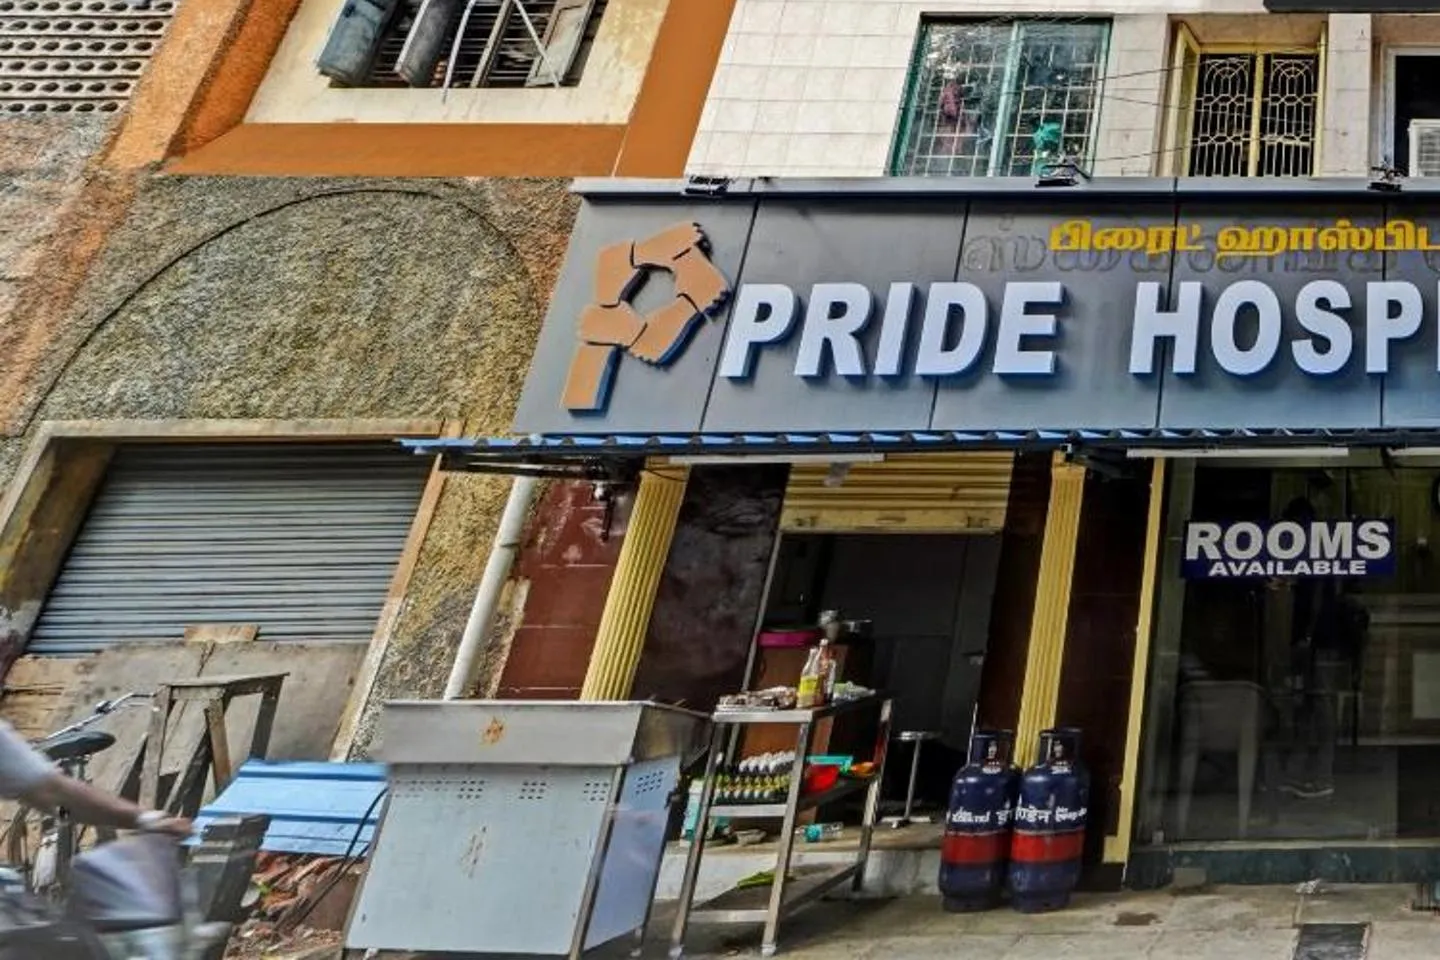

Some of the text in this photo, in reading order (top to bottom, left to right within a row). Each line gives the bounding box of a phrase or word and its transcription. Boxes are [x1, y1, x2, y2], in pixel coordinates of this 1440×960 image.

[719, 280, 1066, 380] PRIDE
[1185, 520, 1391, 561] ROOMS
[1208, 560, 1368, 577] AVAILABLE
